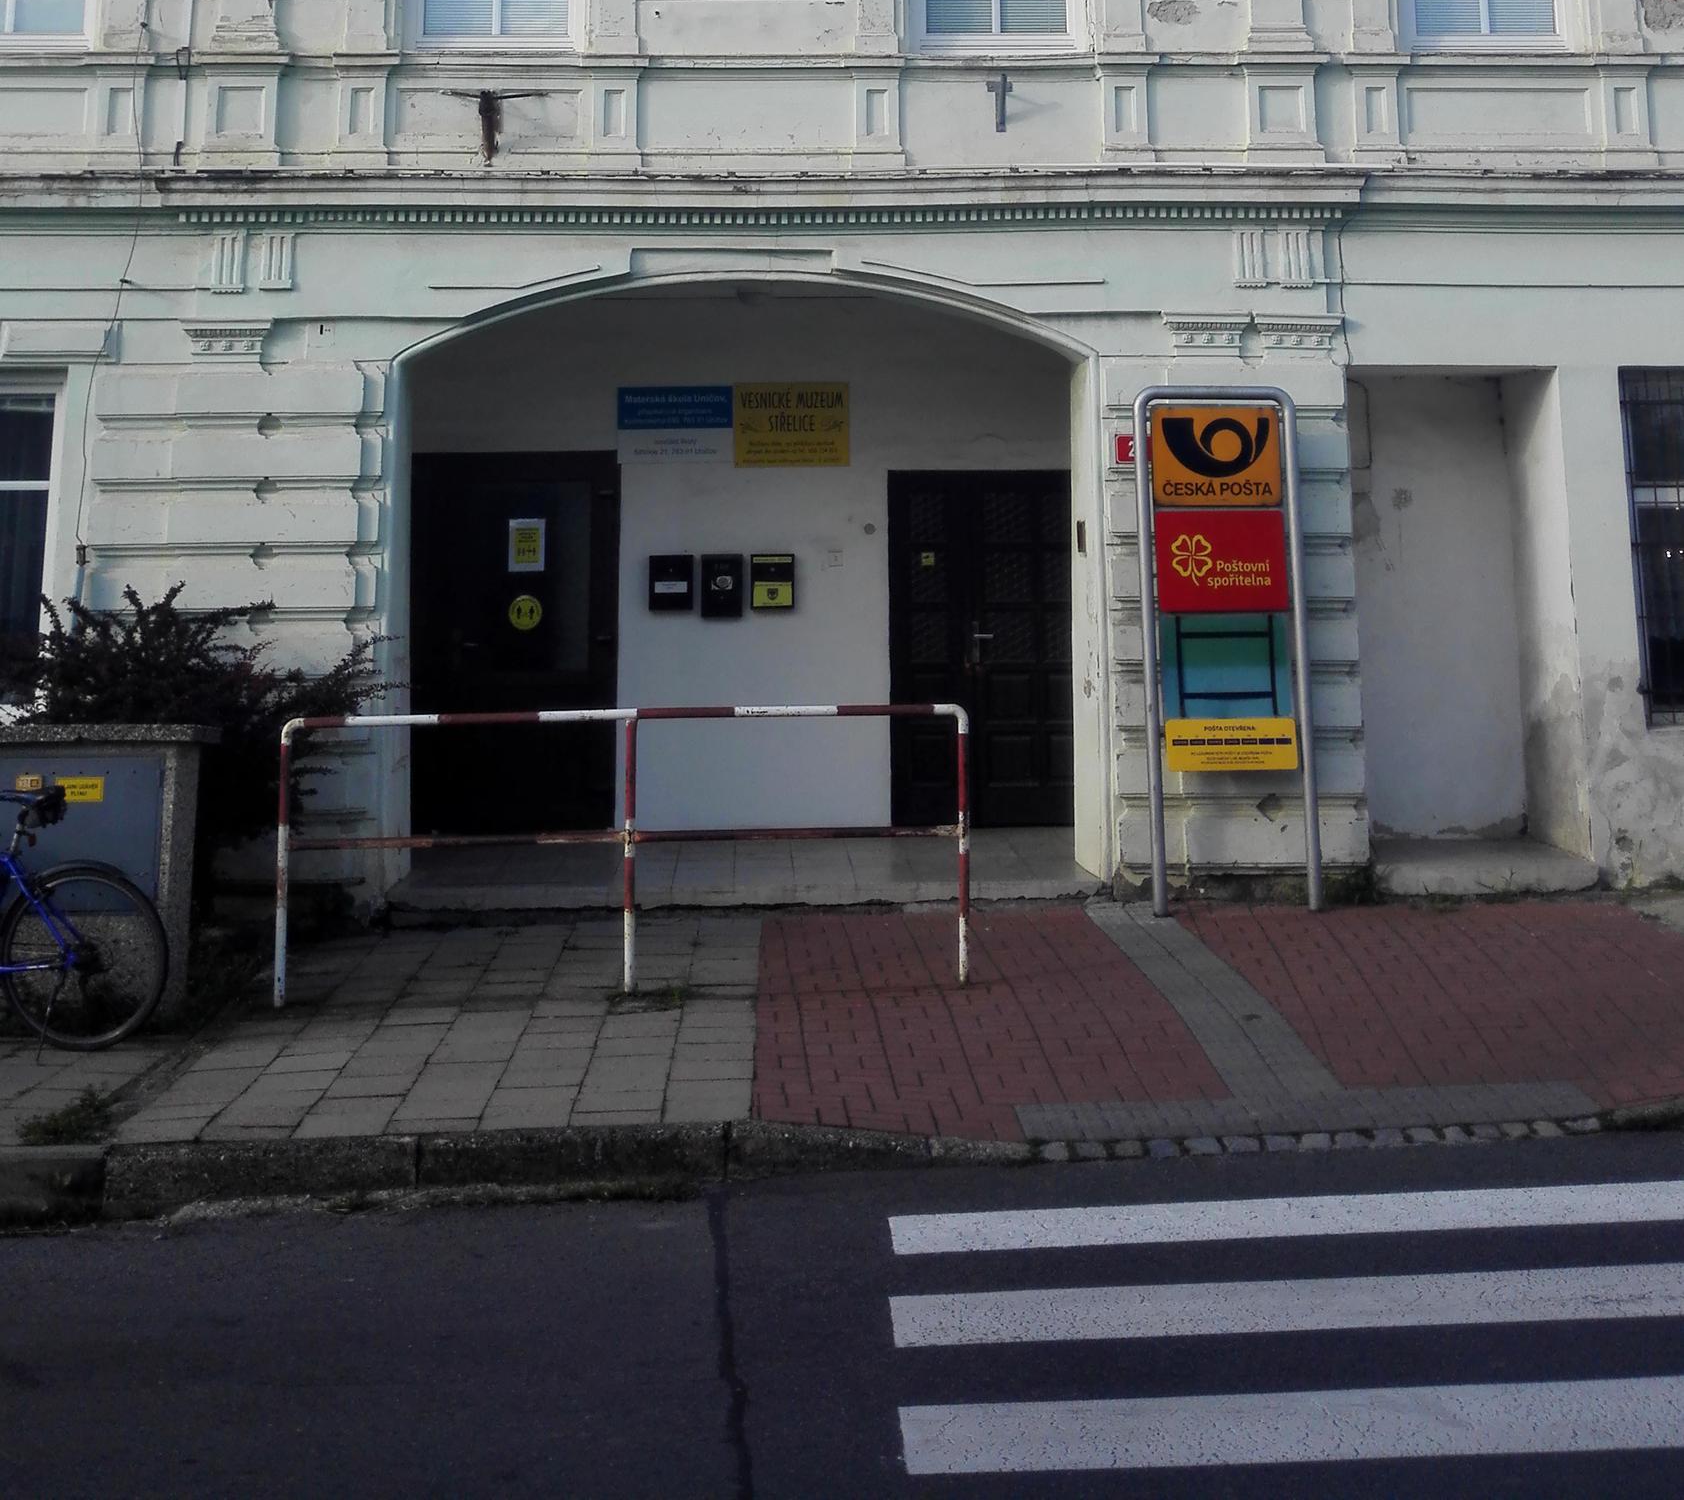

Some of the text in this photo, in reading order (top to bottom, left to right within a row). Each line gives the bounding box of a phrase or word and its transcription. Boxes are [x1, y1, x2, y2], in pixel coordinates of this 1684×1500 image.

[740, 388, 844, 409] VESNICKÉ MUZEUM
[768, 411, 816, 433] STŘELICE
[1163, 479, 1273, 496] ČESKÁ POŠTA
[1216, 559, 1270, 572] Poštovní
[1207, 573, 1272, 588] spořitelna
